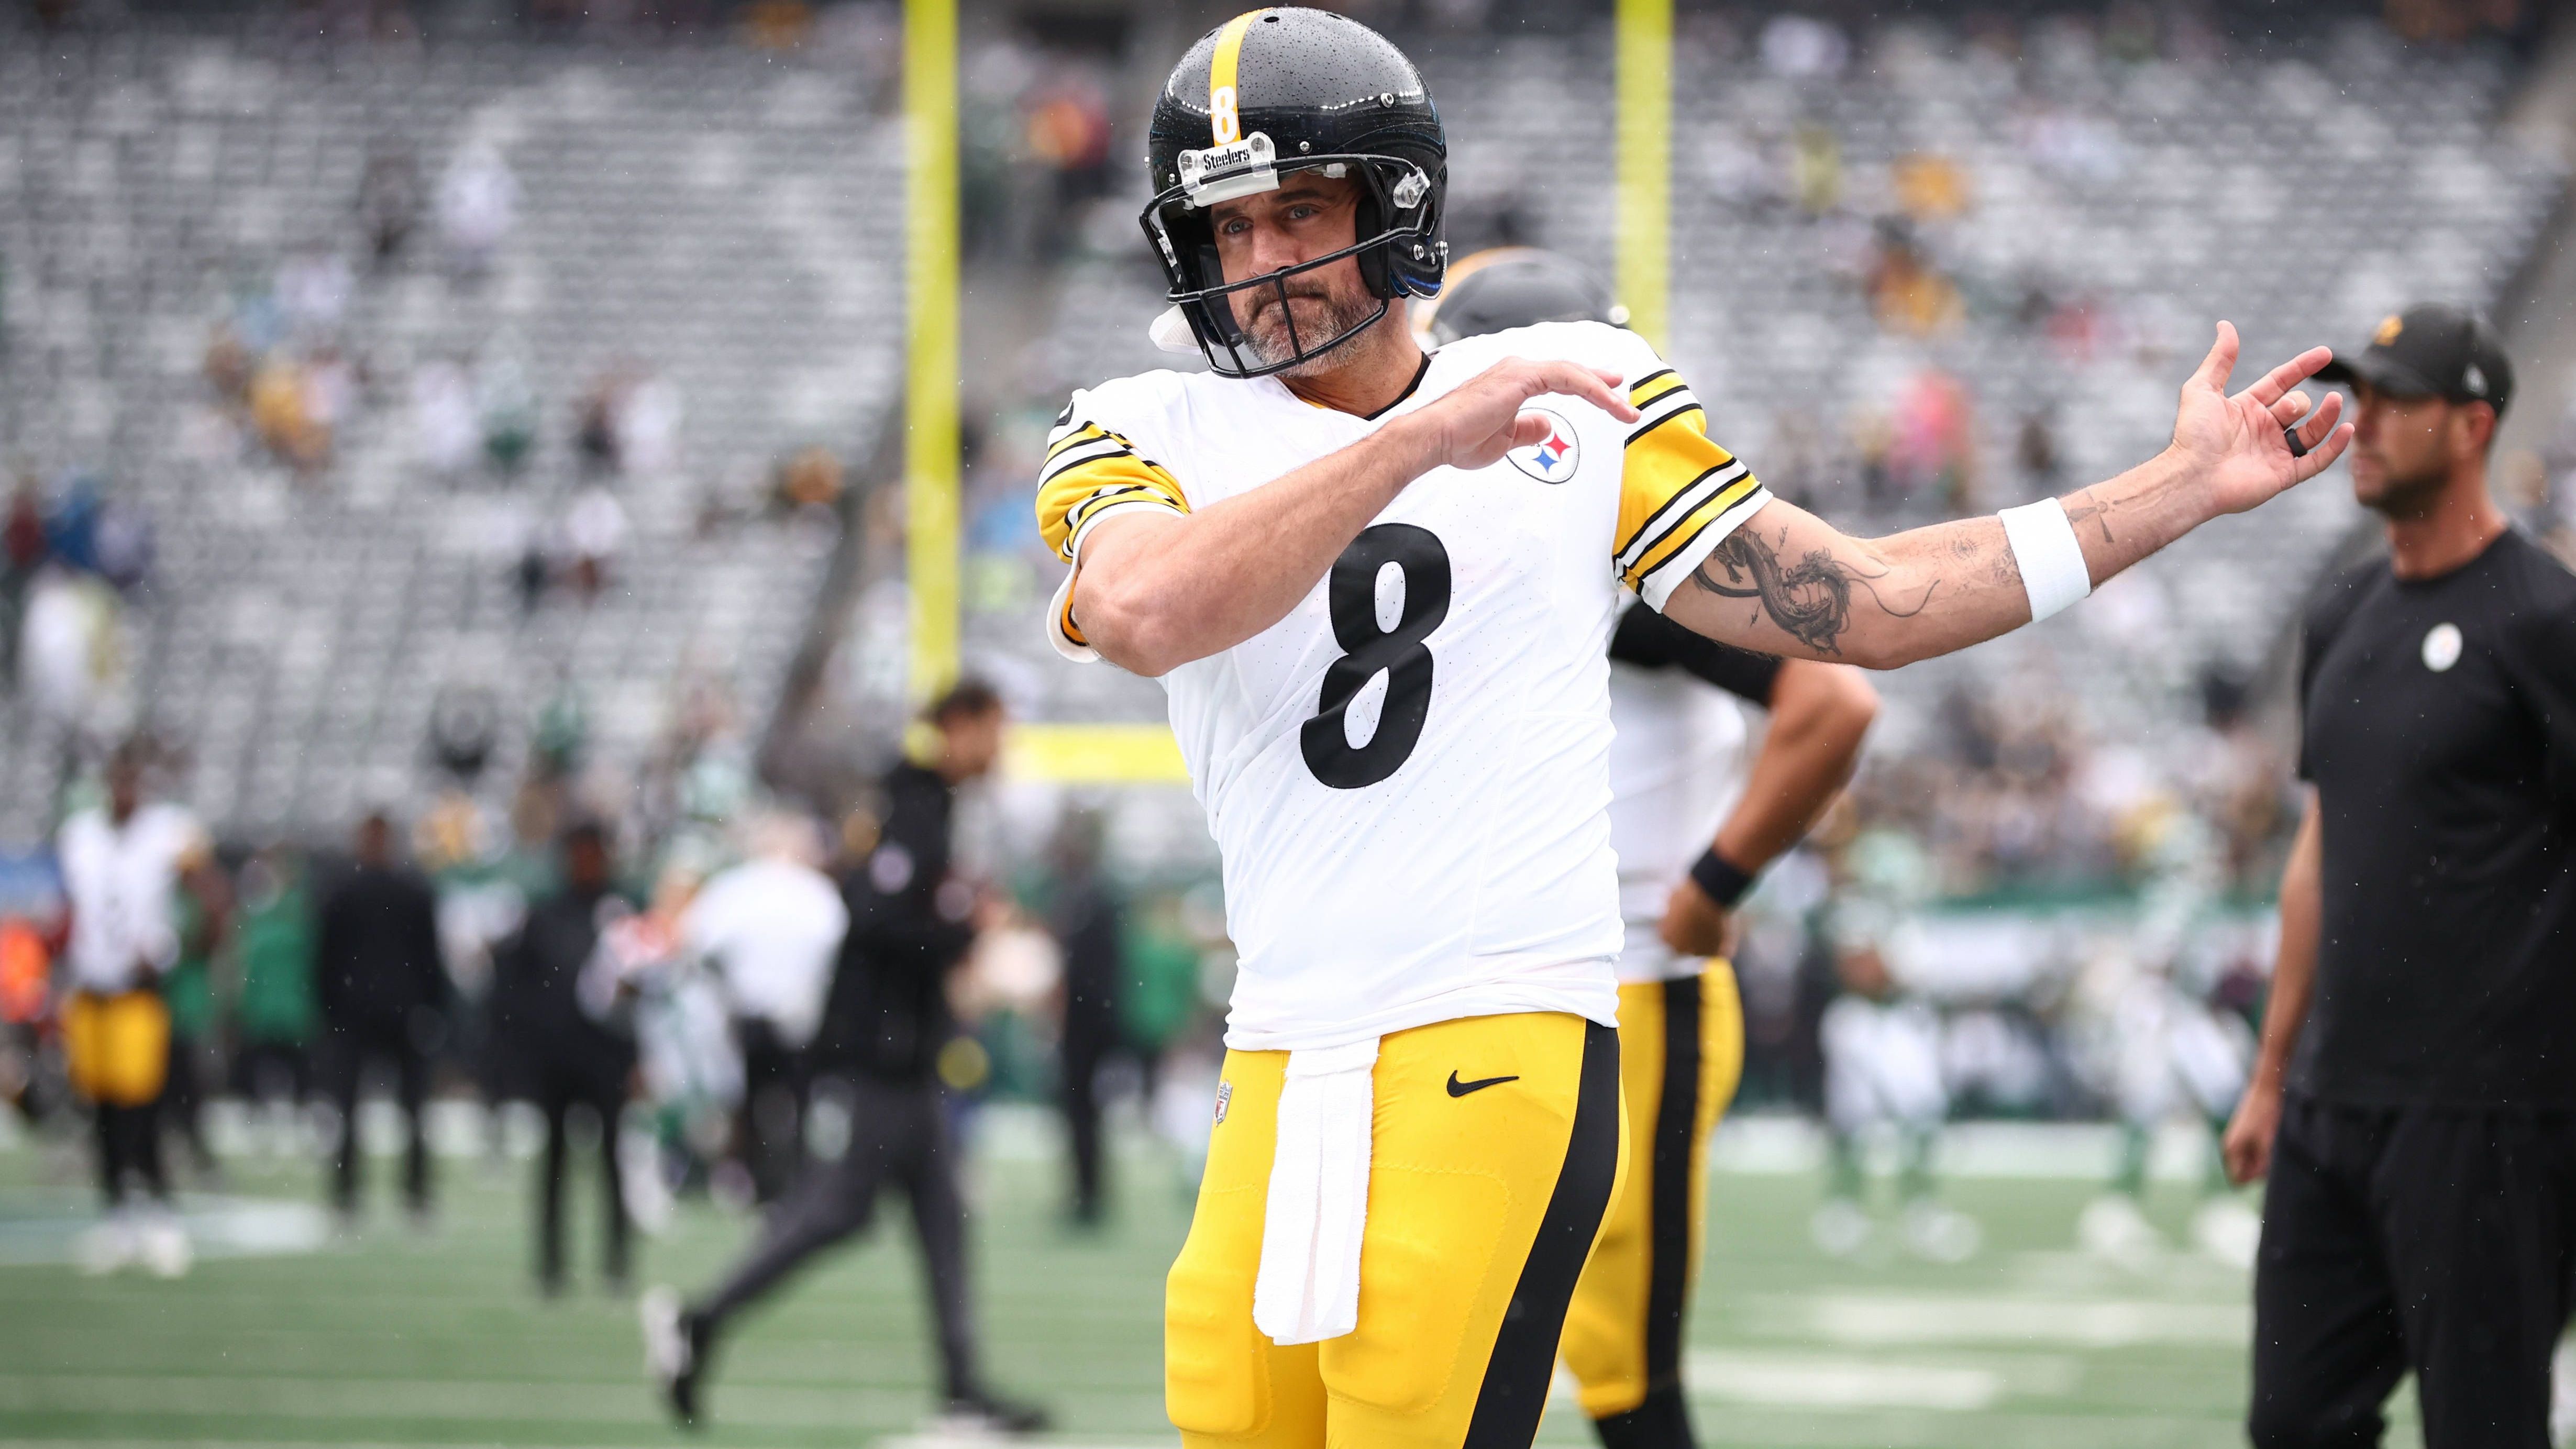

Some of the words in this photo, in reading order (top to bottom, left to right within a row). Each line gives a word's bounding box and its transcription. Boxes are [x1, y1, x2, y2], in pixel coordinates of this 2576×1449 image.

[1211, 86, 1237, 144] 8
[1203, 148, 1250, 171] Steelers
[1300, 522, 1452, 789] 8
